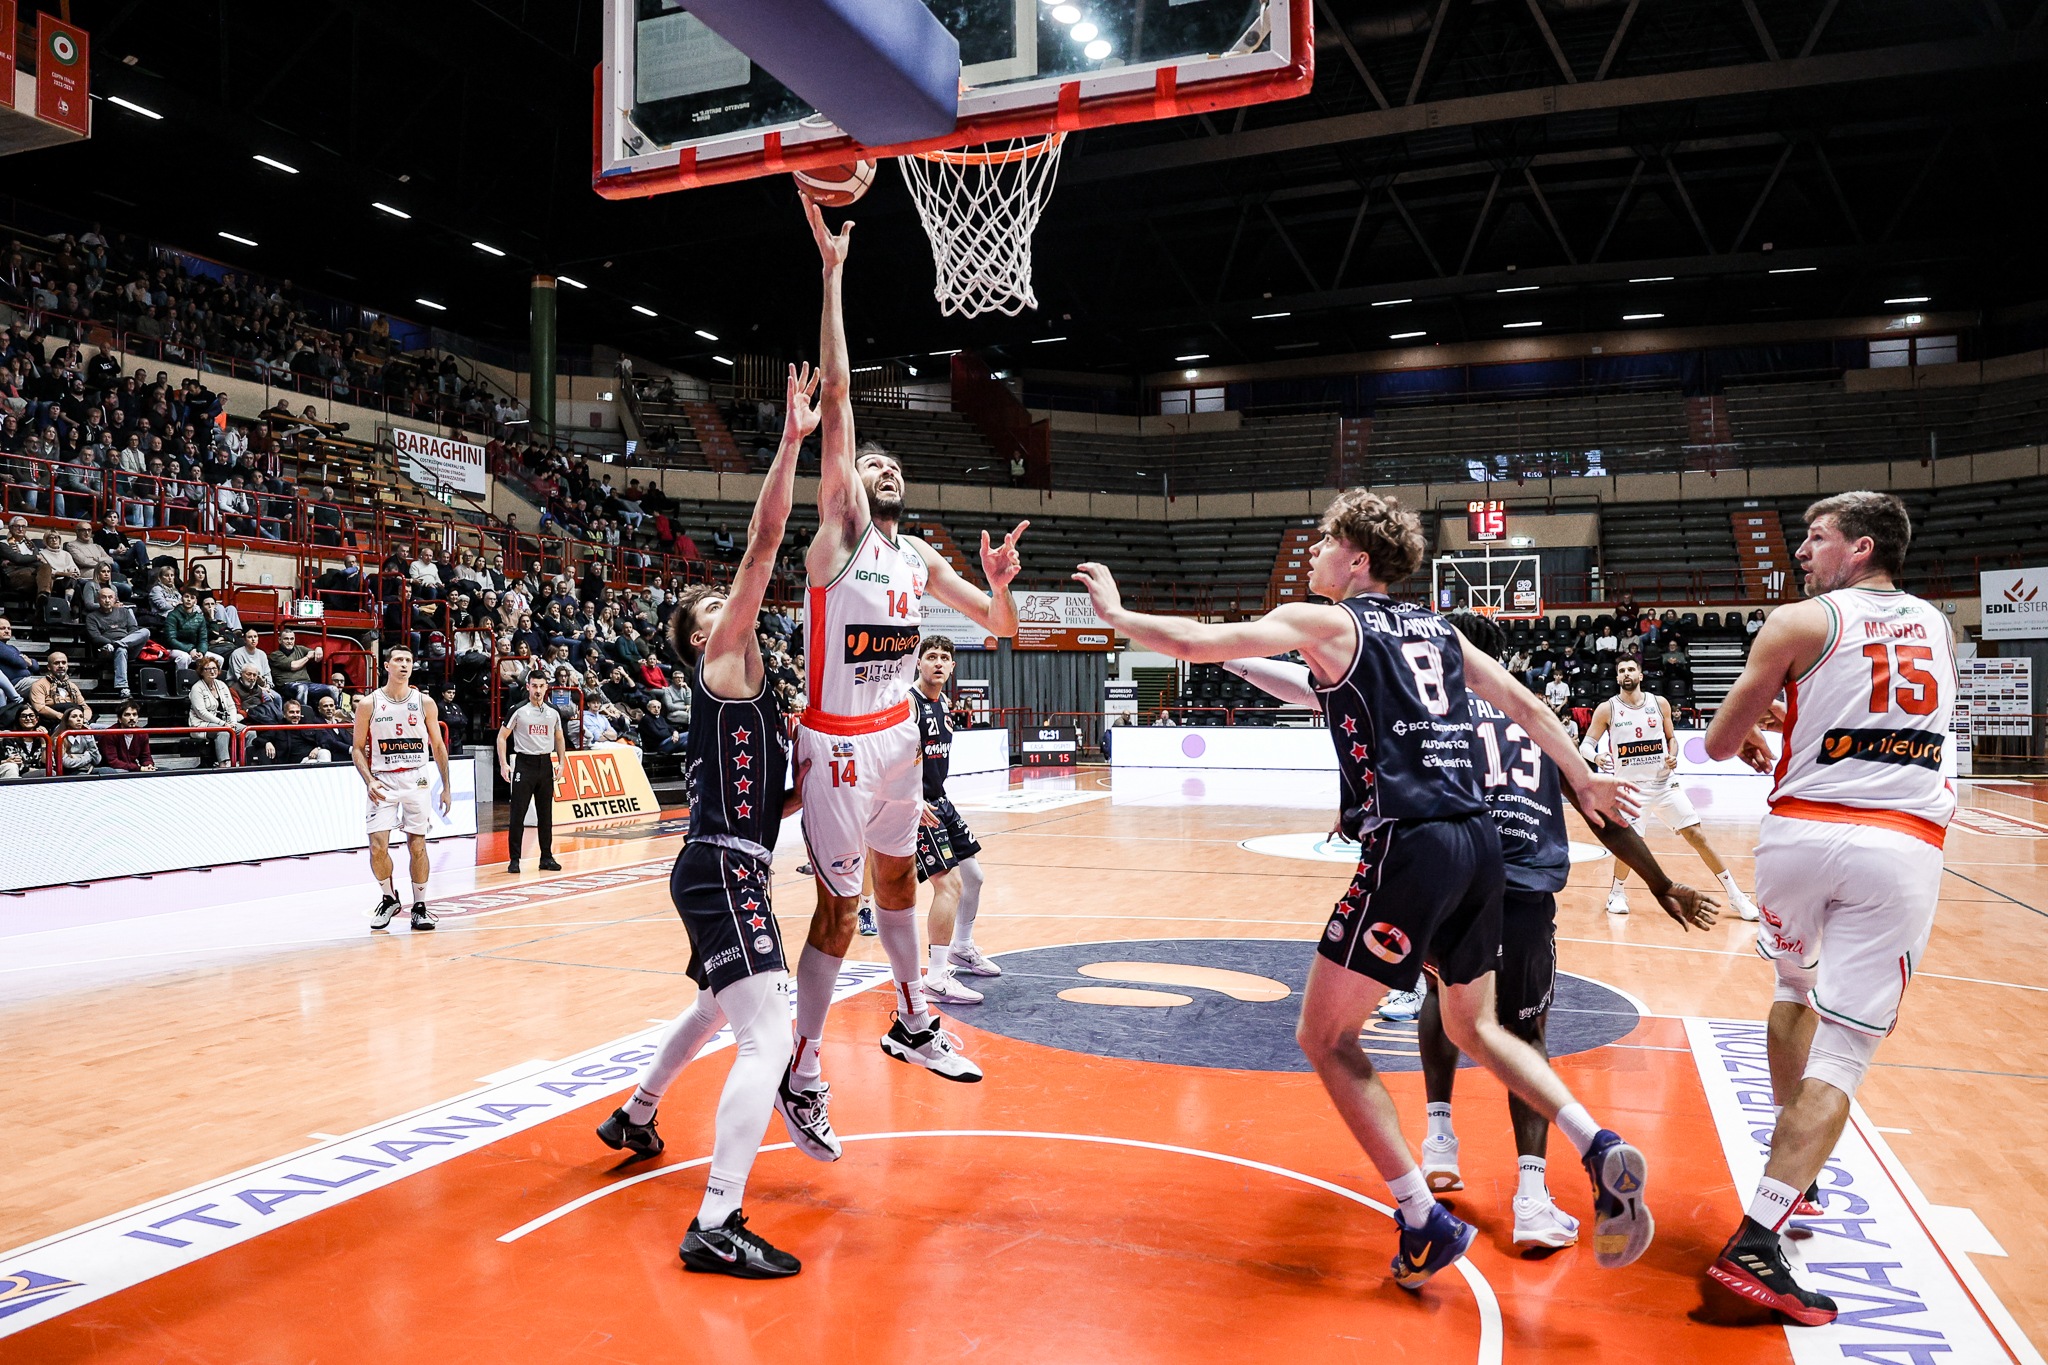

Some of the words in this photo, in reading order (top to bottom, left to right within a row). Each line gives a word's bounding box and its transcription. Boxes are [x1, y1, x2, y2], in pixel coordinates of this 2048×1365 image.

[397, 431, 482, 466] BARAGHINI
[1478, 512, 1504, 533] 15
[855, 569, 890, 584] IGNIS
[886, 589, 909, 619] 14
[1065, 597, 1091, 606] BANC
[1985, 603, 2016, 614] EDIL
[1064, 607, 1096, 617] GENER
[1065, 617, 1096, 625] PRIVATE
[1864, 621, 1928, 640] MAGRO
[1400, 639, 1450, 716] 8
[1862, 642, 1939, 716] 15
[395, 723, 403, 736] 5
[926, 716, 940, 736] 21
[1409, 722, 1430, 731] BCC
[1635, 726, 1643, 739] 8
[1038, 729, 1060, 741] 02:31
[388, 741, 423, 752] unieuro
[1628, 743, 1662, 754] unieuro
[1029, 754, 1040, 763] 11
[1059, 754, 1070, 763] 15
[1476, 721, 1542, 793] 13
[1629, 755, 1661, 764] ITALIANA
[829, 759, 858, 788] 14
[572, 797, 641, 819] BATTERIE
[711, 952, 721, 963] GAS
[721, 945, 740, 957] SALES
[712, 952, 742, 969] ENERGIA
[122, 1101, 552, 1249] ITALIANA
